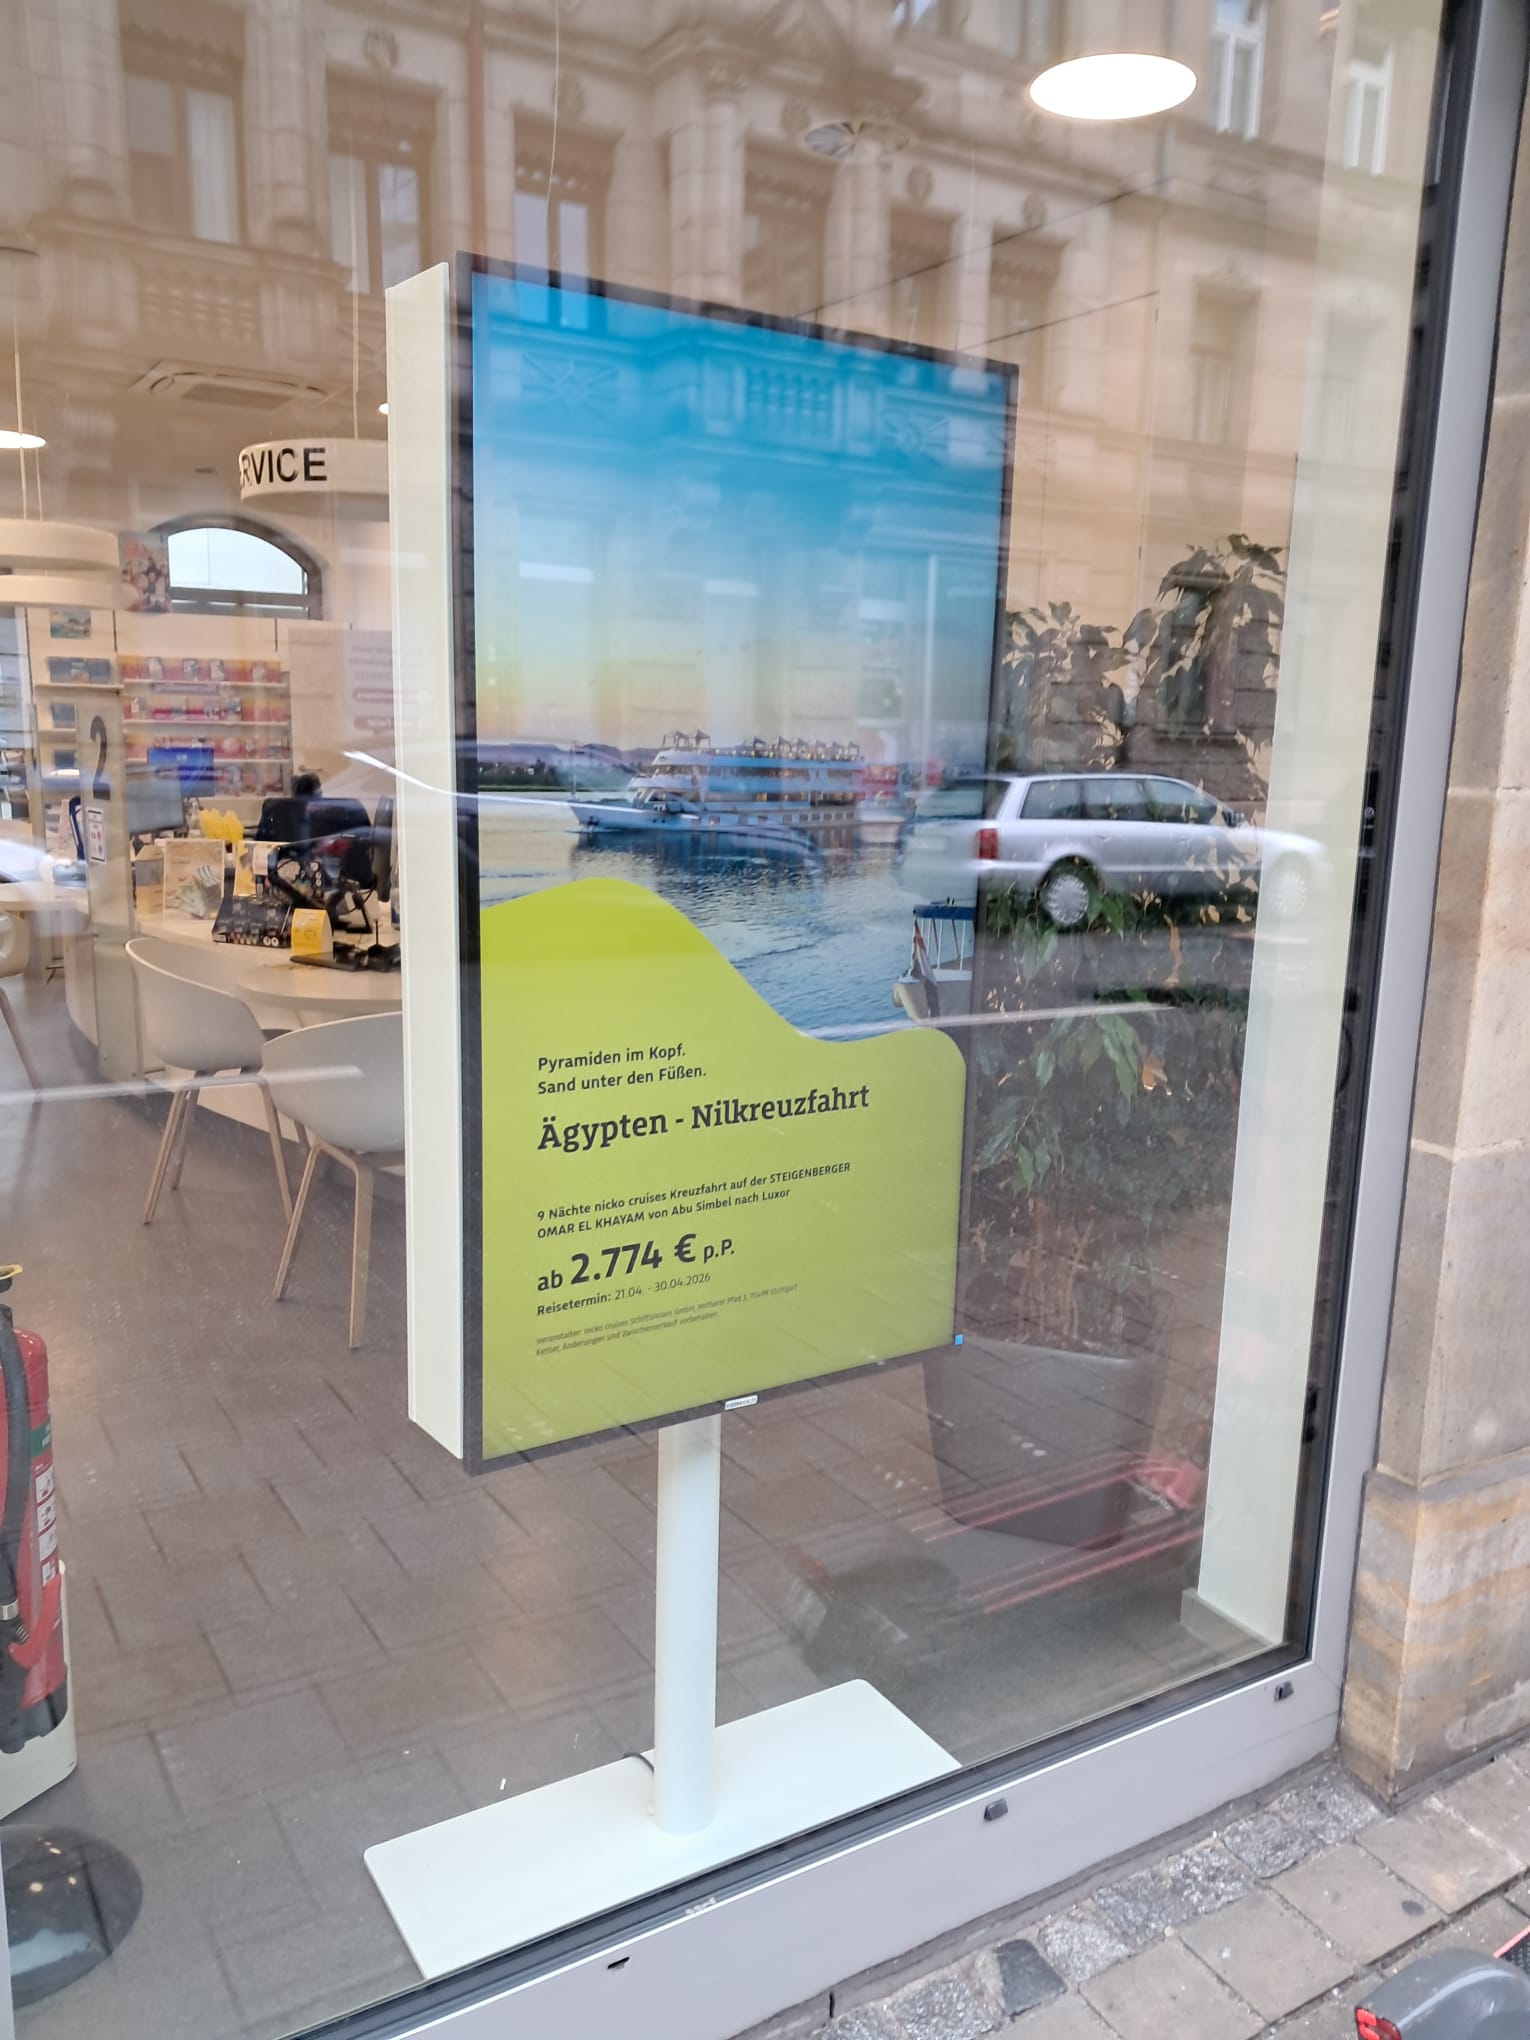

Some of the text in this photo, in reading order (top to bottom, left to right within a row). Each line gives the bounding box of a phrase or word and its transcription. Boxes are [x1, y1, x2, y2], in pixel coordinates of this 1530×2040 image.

[240, 447, 327, 488] RVICE
[538, 1043, 686, 1073] Pyramiden im Kopf.
[538, 1065, 707, 1094] Sand unter den Füßen.
[537, 1113, 668, 1153] Ägypten
[691, 1085, 870, 1129] Nilkreuzfahrt
[537, 1162, 851, 1222] 9 Nächte nicko cruises Kreuzfahrt auf der STEIGENBERGER
[537, 1188, 791, 1239] OMAR EL KHAYAM von Abu Simbel nach Luxor
[537, 1233, 735, 1292] ab 2.774 € p.P.
[537, 1292, 612, 1316] Reisetermin:
[654, 1272, 711, 1293] 30.04.2026
